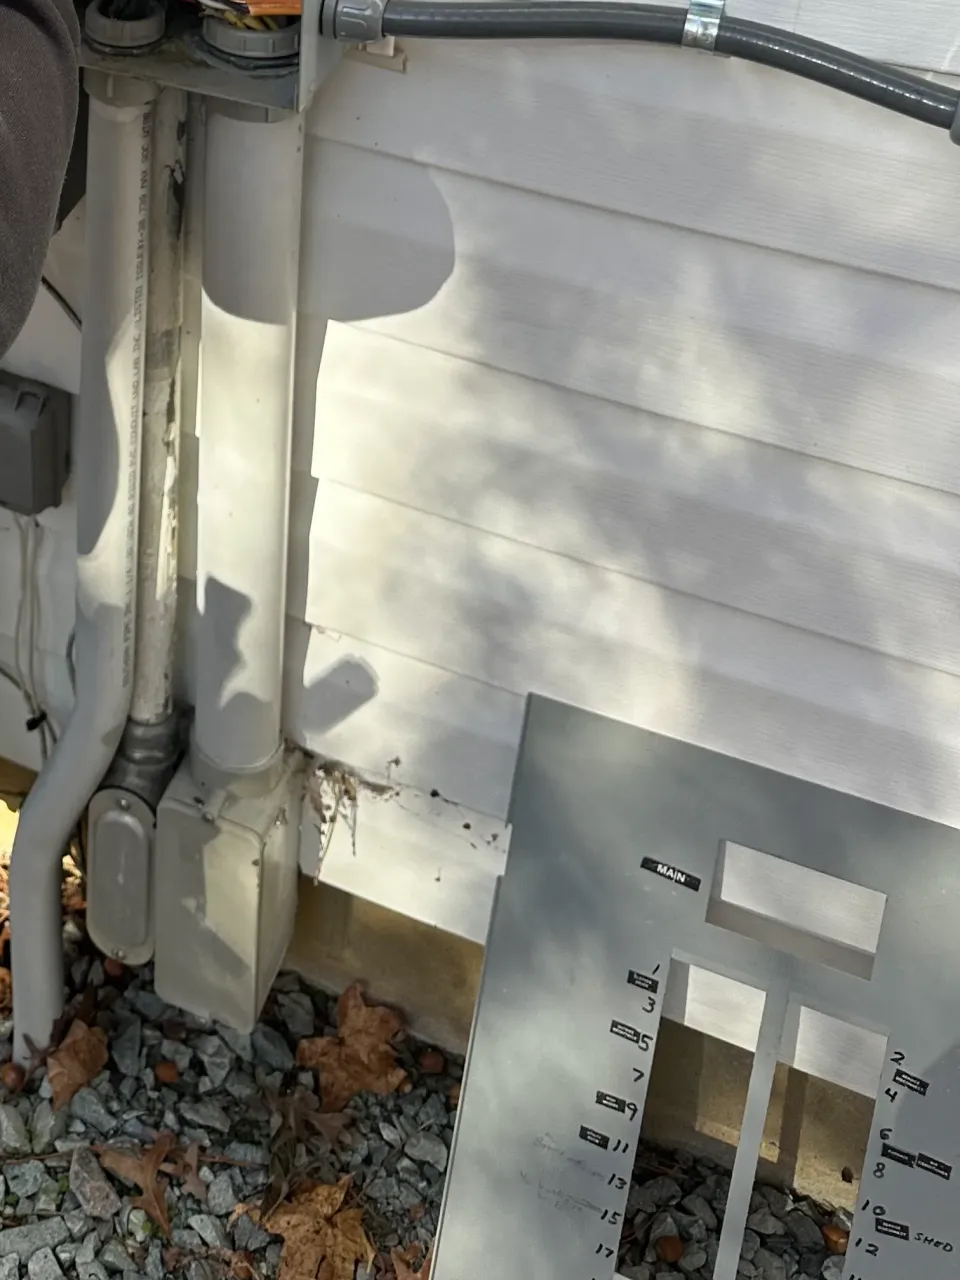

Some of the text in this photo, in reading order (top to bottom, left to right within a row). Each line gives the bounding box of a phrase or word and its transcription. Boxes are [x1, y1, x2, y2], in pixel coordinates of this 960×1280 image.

[657, 864, 686, 883] MAIN
[652, 963, 660, 975] 1
[642, 995, 656, 1013] 3
[638, 1033, 653, 1052] 5
[890, 1051, 905, 1066] 2
[632, 1067, 645, 1082] 7
[884, 1087, 898, 1103] 4
[626, 1102, 638, 1121] 9
[880, 1127, 893, 1140] 6
[612, 1139, 629, 1154] 11
[872, 1162, 886, 1179] 8
[607, 1173, 627, 1190] 13
[861, 1199, 886, 1216] 10
[600, 1209, 622, 1225] 15
[595, 1243, 614, 1258] 17
[855, 1237, 879, 1257] 12
[914, 1232, 953, 1252] SHED
